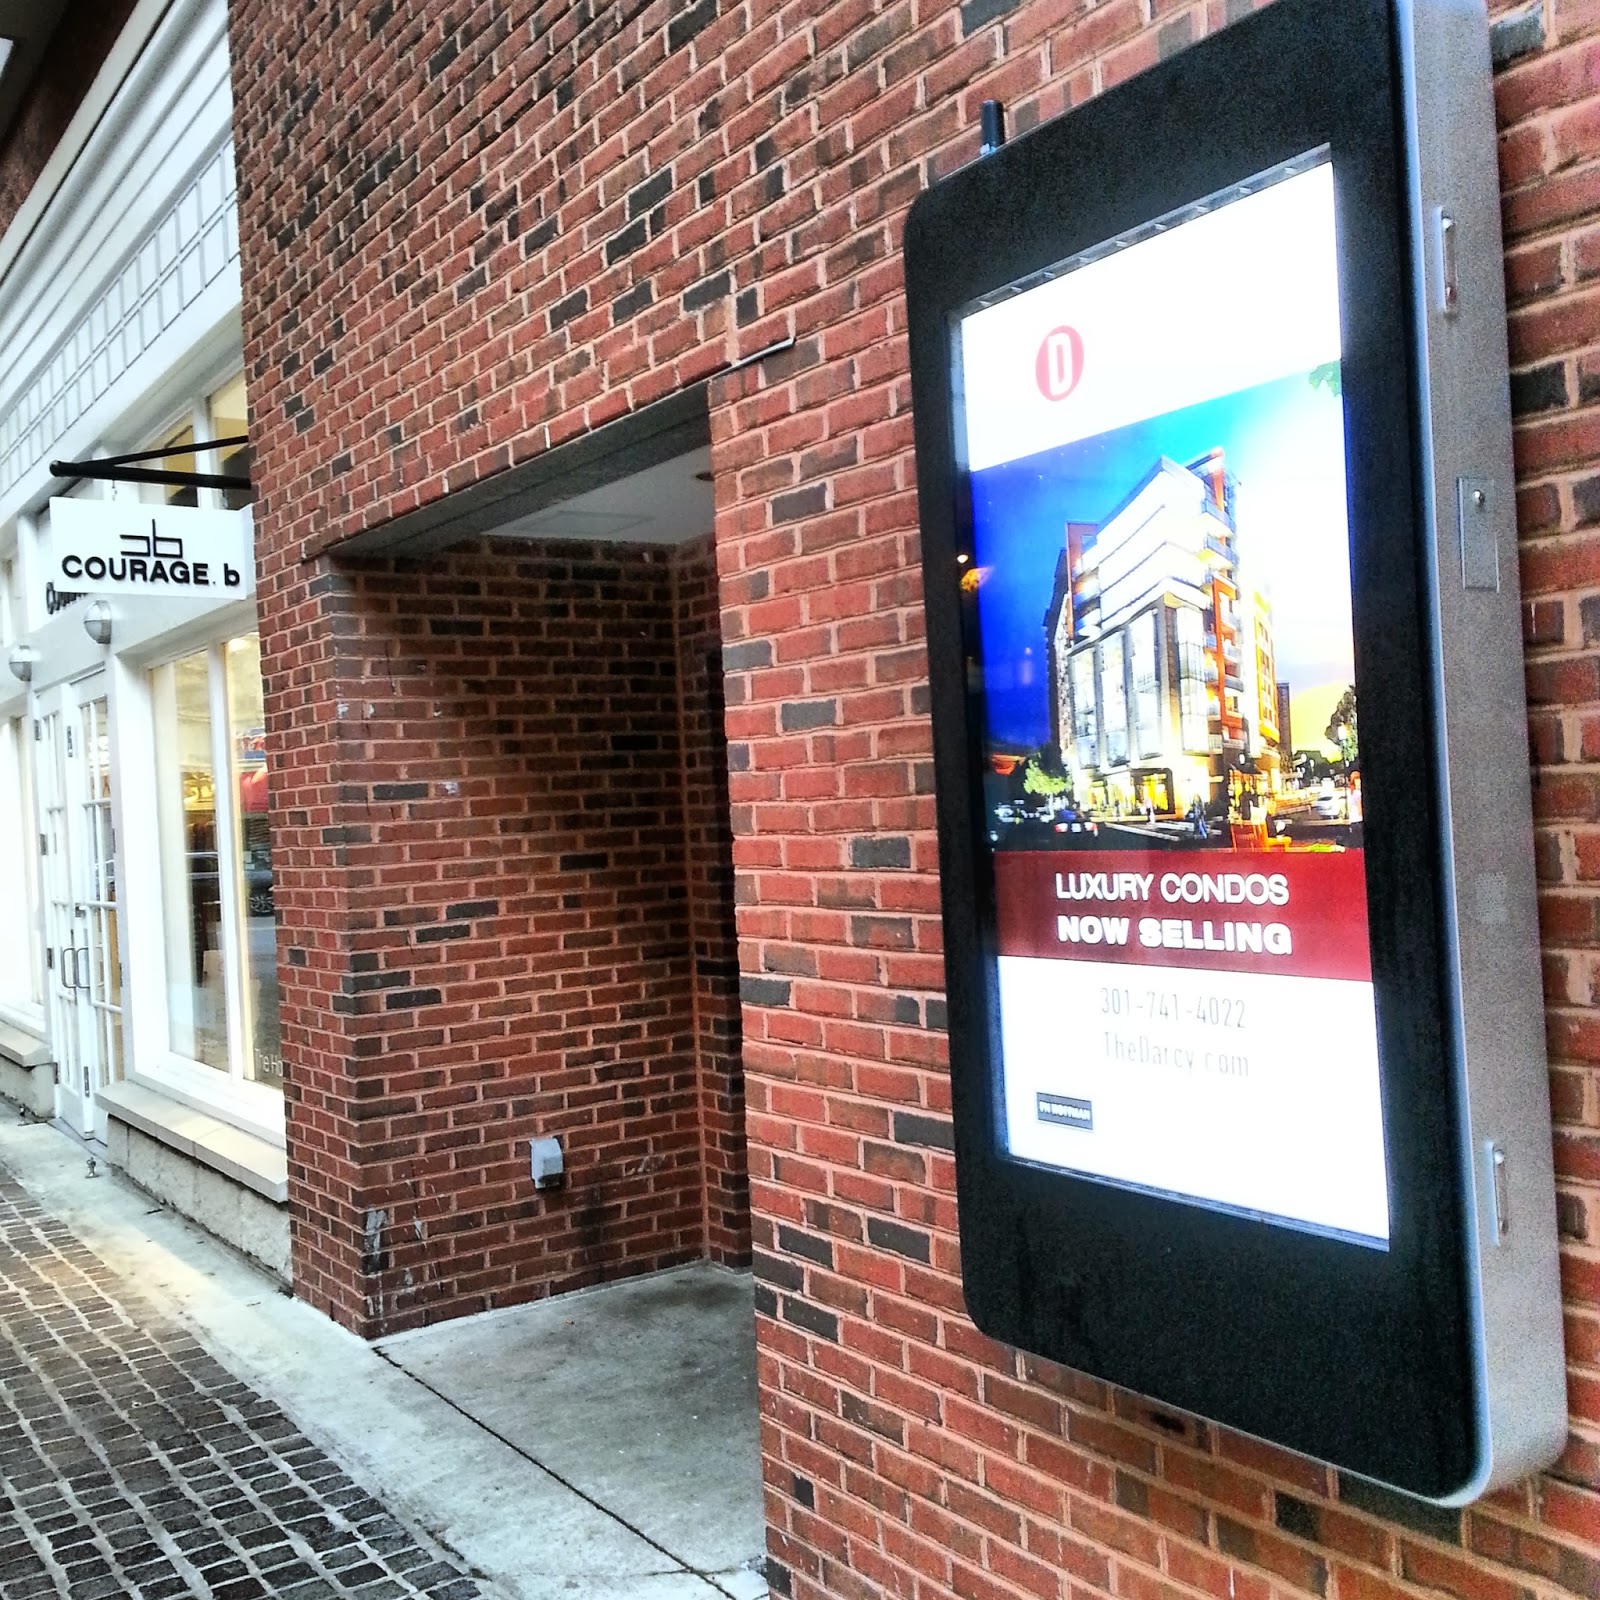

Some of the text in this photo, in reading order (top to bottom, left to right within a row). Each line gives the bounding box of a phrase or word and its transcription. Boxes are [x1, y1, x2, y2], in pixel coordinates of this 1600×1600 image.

[224, 563, 241, 586] b
[1055, 873, 1290, 906] LUXURY CONDOS
[1057, 915, 1293, 954] NOW SELLING
[1100, 987, 1246, 1029] 301-741-4022
[1104, 1031, 1249, 1078] TheDarcycom
